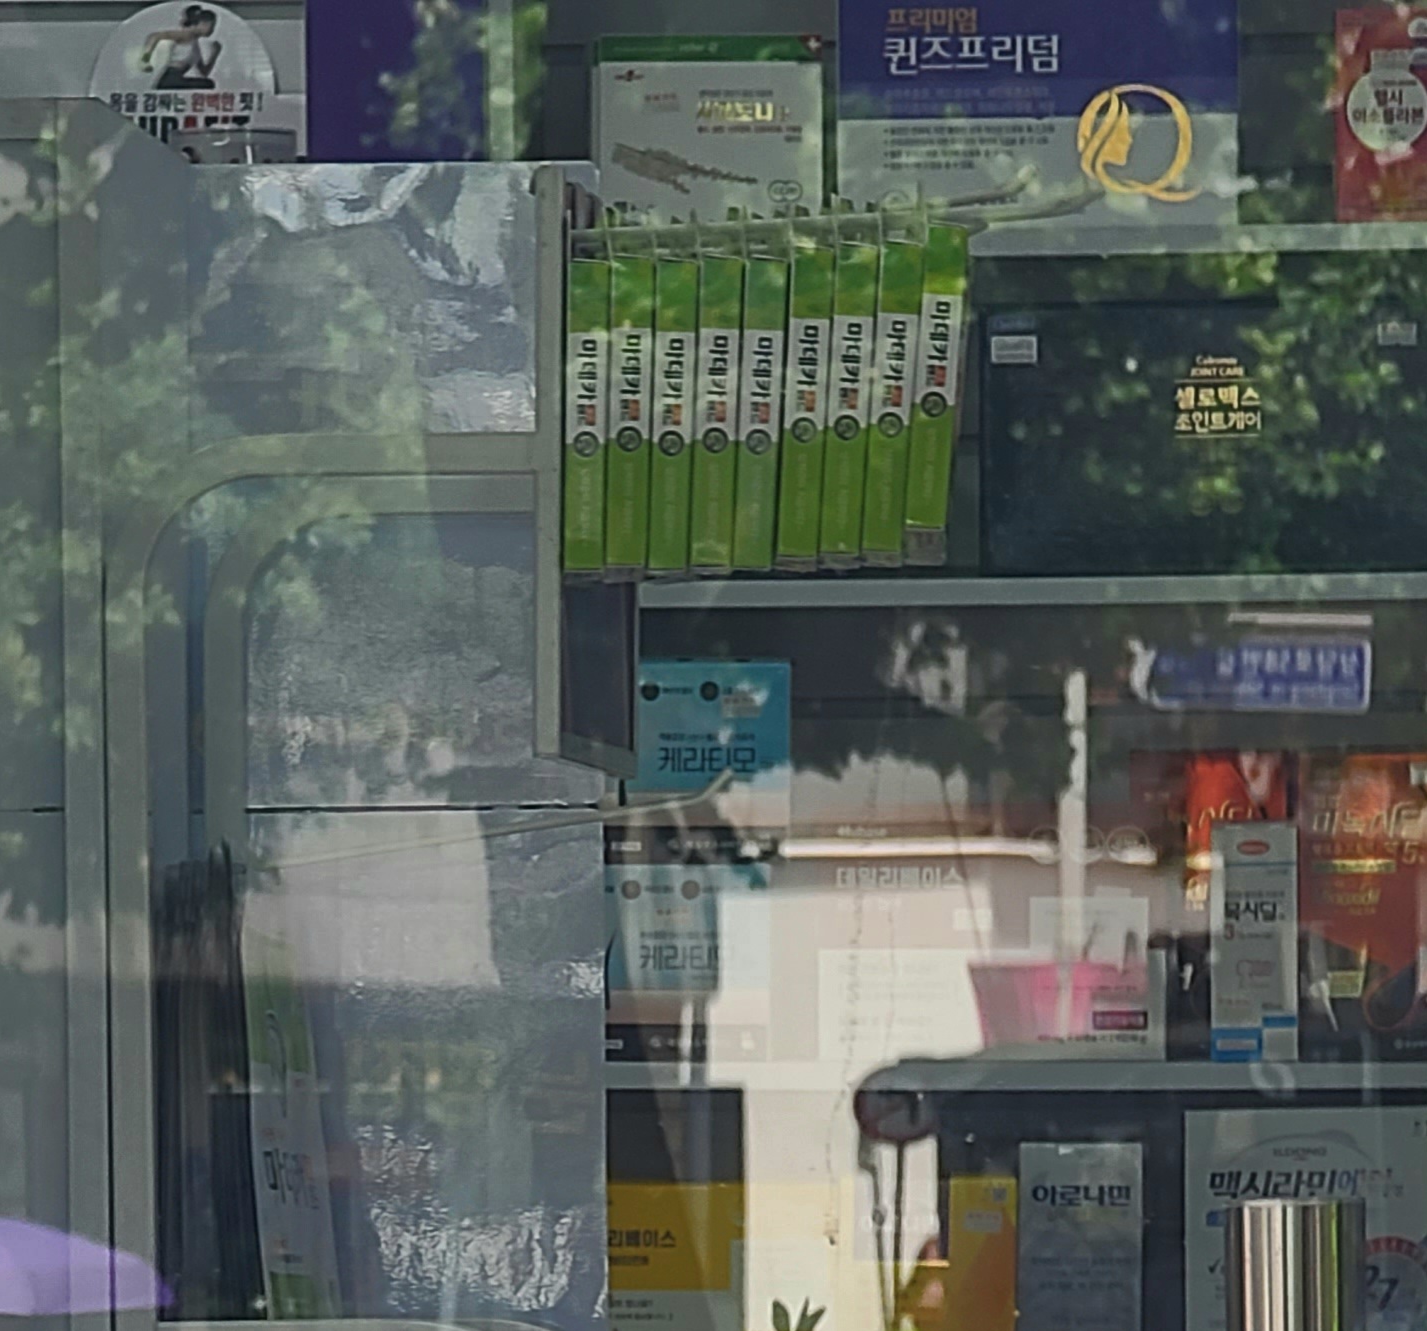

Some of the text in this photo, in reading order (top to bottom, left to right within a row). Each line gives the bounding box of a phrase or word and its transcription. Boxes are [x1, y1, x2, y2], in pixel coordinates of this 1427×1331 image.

[886, 7, 980, 35] 프리미엄
[884, 35, 1060, 76] 퀸즈프리덤
[795, 324, 821, 388] 마데카
[838, 322, 865, 386] 마데카
[882, 319, 909, 385] 마데카
[926, 300, 952, 363] 마데카
[575, 338, 599, 402] 마데카
[619, 333, 642, 398] 마데카
[661, 337, 686, 401] 마데카
[705, 334, 730, 399] 마데카
[749, 335, 774, 400] 마데카
[1031, 1184, 1131, 1207] 아로나민
